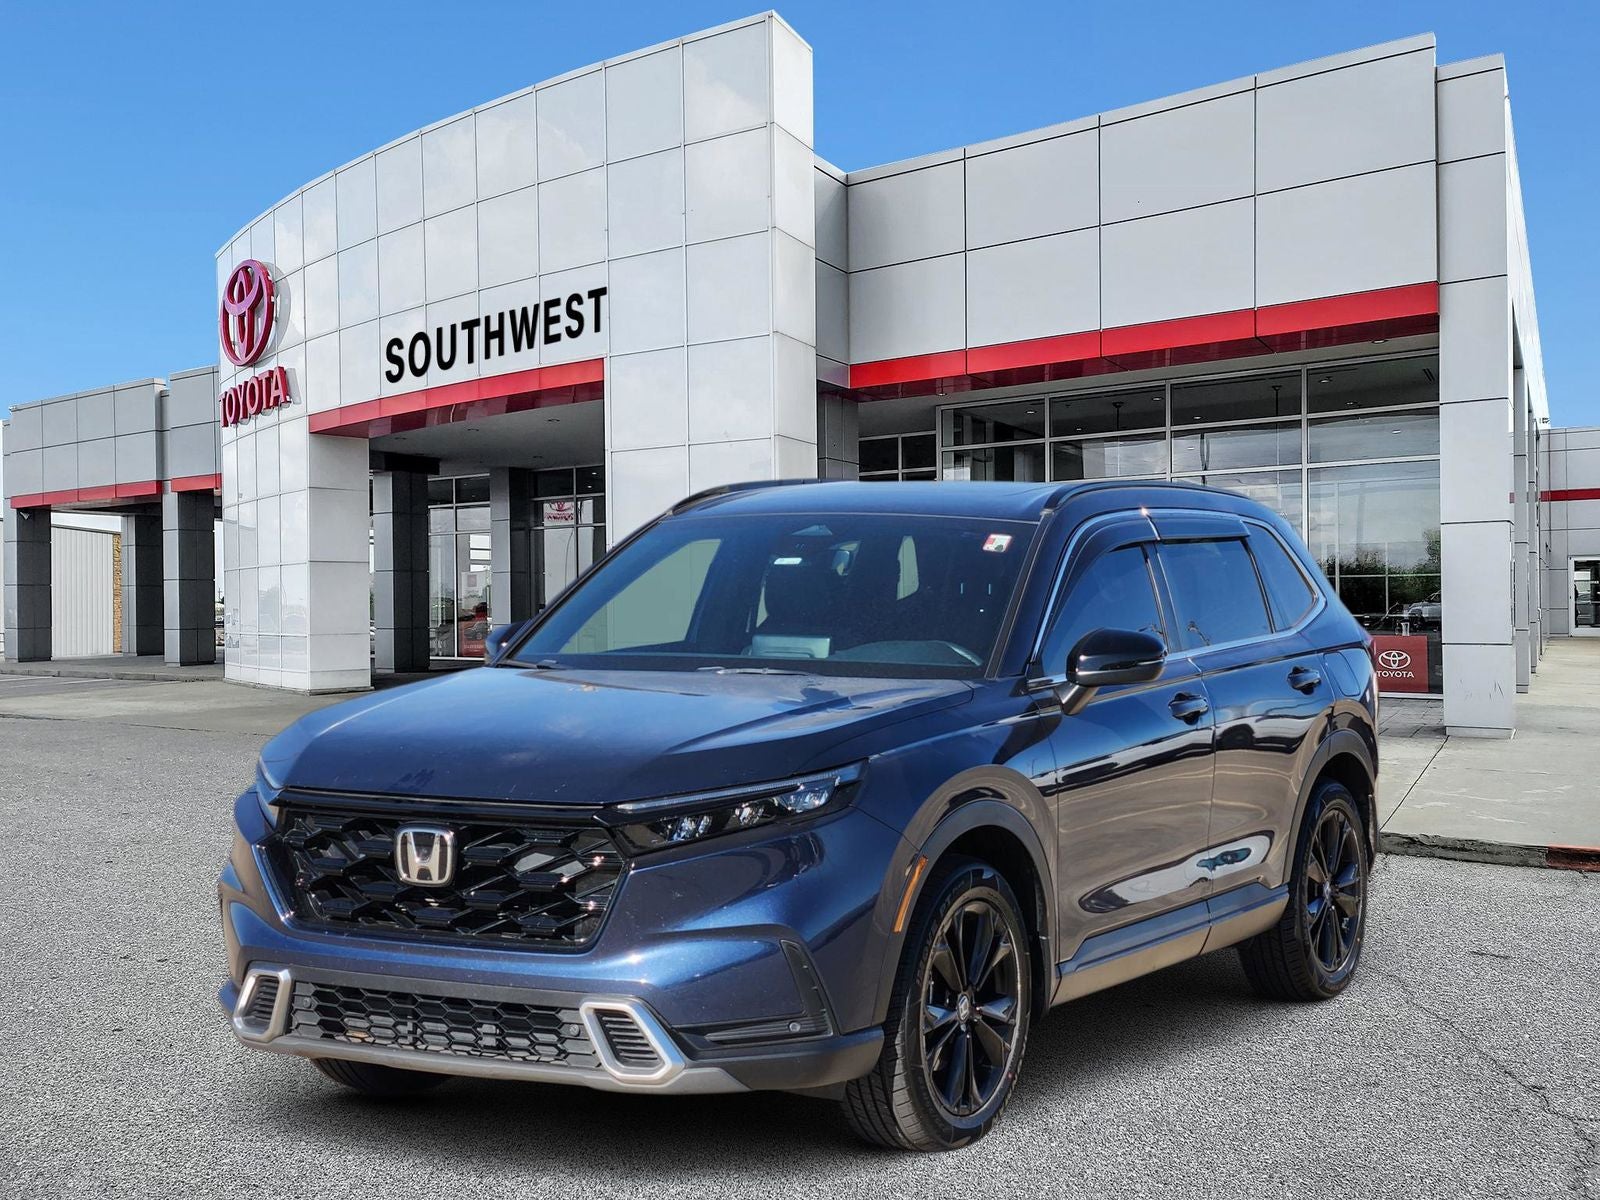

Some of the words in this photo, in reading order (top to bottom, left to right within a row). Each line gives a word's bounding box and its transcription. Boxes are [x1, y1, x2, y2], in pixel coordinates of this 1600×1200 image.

[385, 287, 608, 383] SOUTHWEST
[219, 366, 290, 428] TOYOTA
[1376, 670, 1415, 678] TOYOTA
